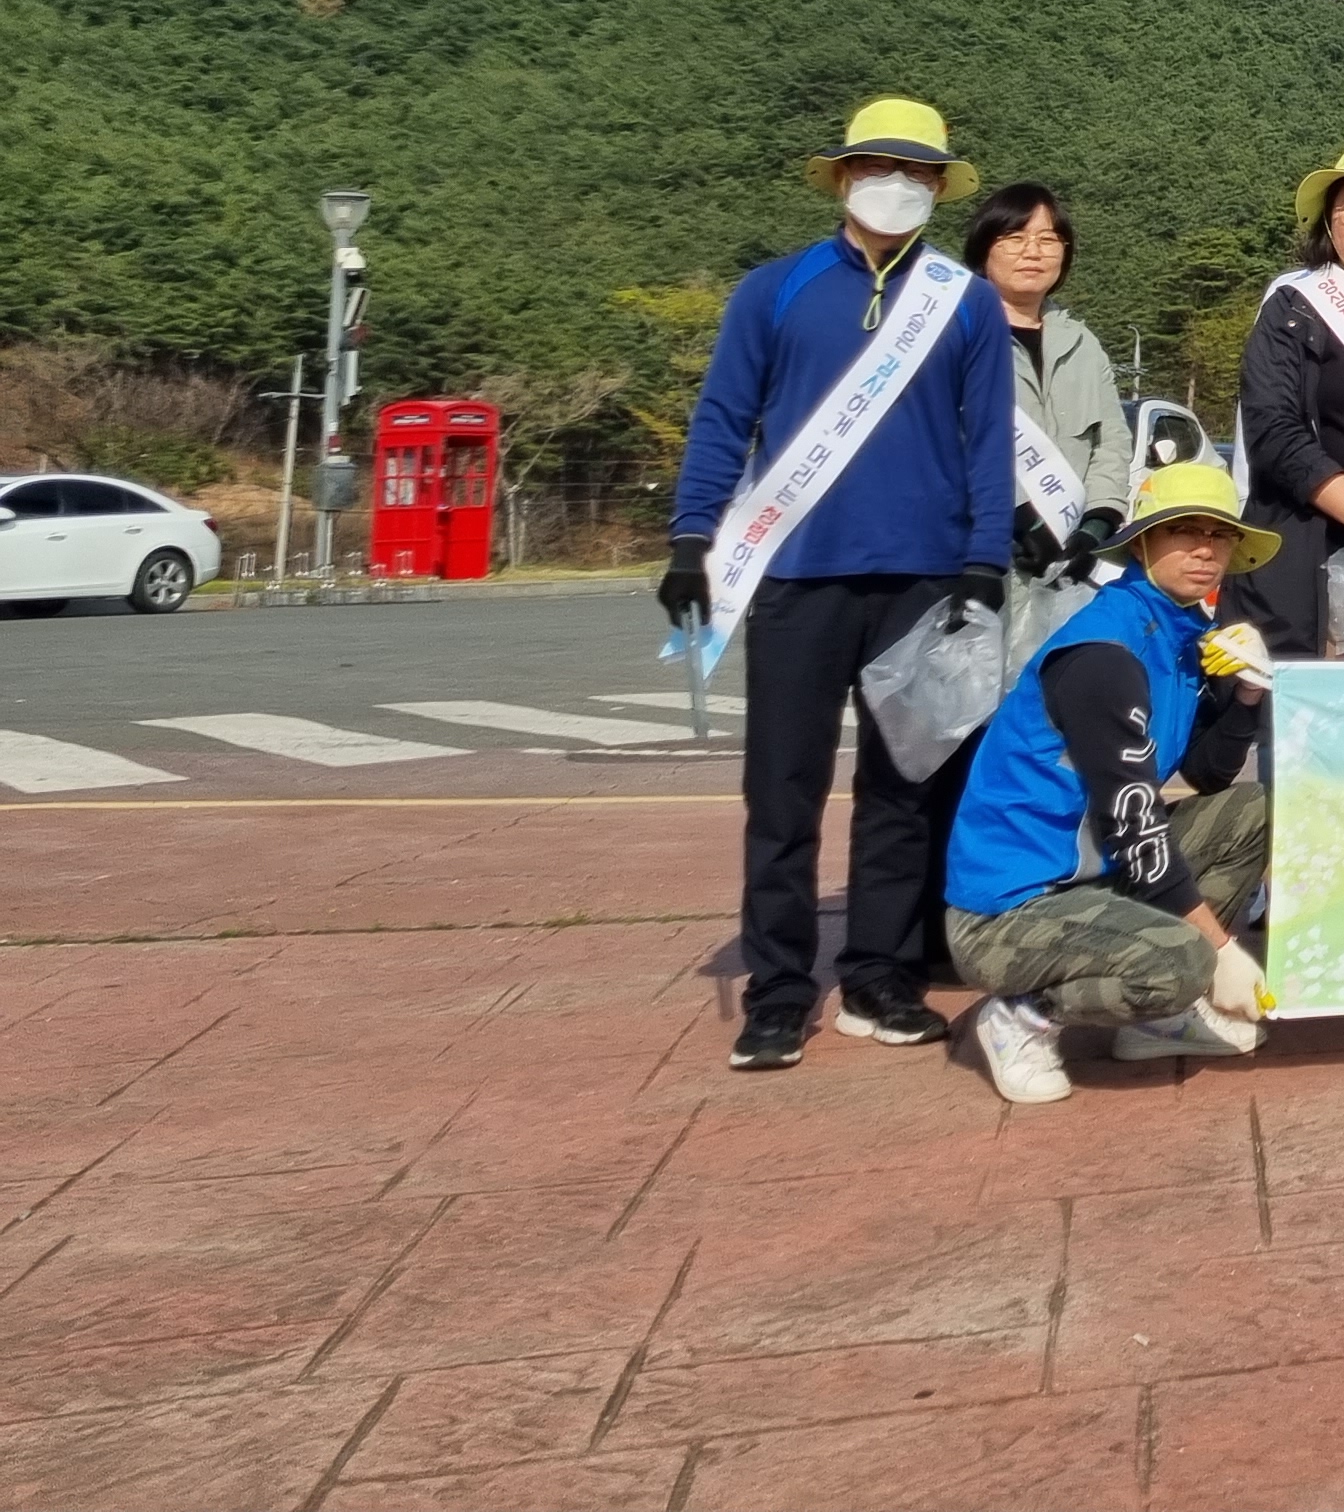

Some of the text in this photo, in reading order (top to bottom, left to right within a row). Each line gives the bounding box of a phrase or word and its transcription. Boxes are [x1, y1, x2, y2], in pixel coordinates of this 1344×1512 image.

[895, 292, 939, 354] 가슴은
[824, 353, 901, 438] 감사하게,
[774, 443, 832, 507] 머리는
[723, 505, 783, 588] 청렴하게
